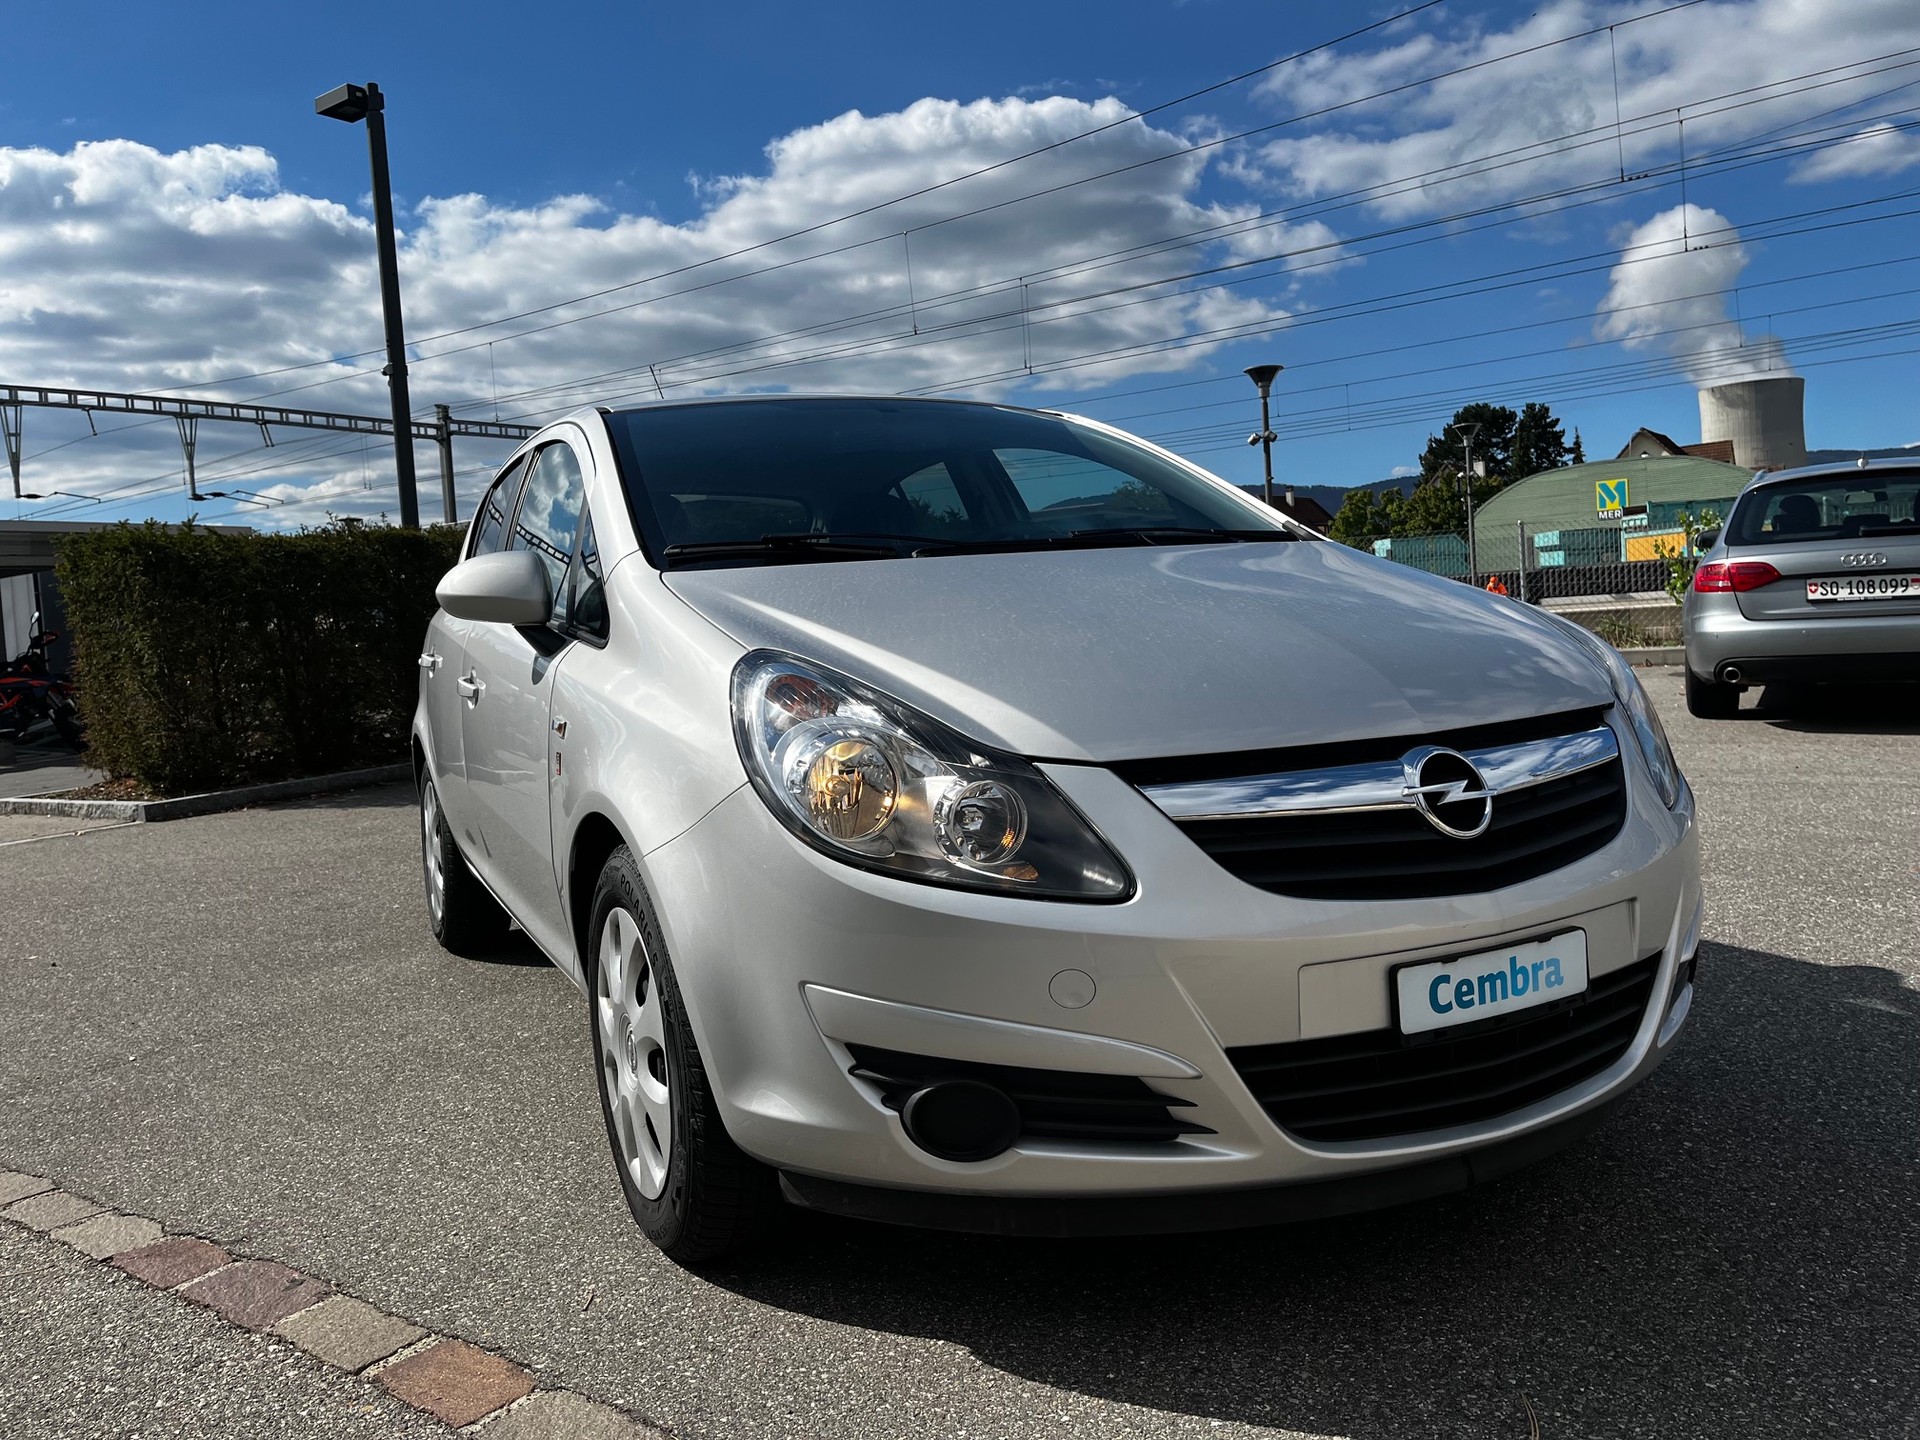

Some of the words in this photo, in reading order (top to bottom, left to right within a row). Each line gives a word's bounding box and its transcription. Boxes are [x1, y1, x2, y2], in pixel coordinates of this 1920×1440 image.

[1598, 511, 1622, 519] MER
[620, 873, 653, 947] POLARIS
[1428, 955, 1565, 1015] Cembra
